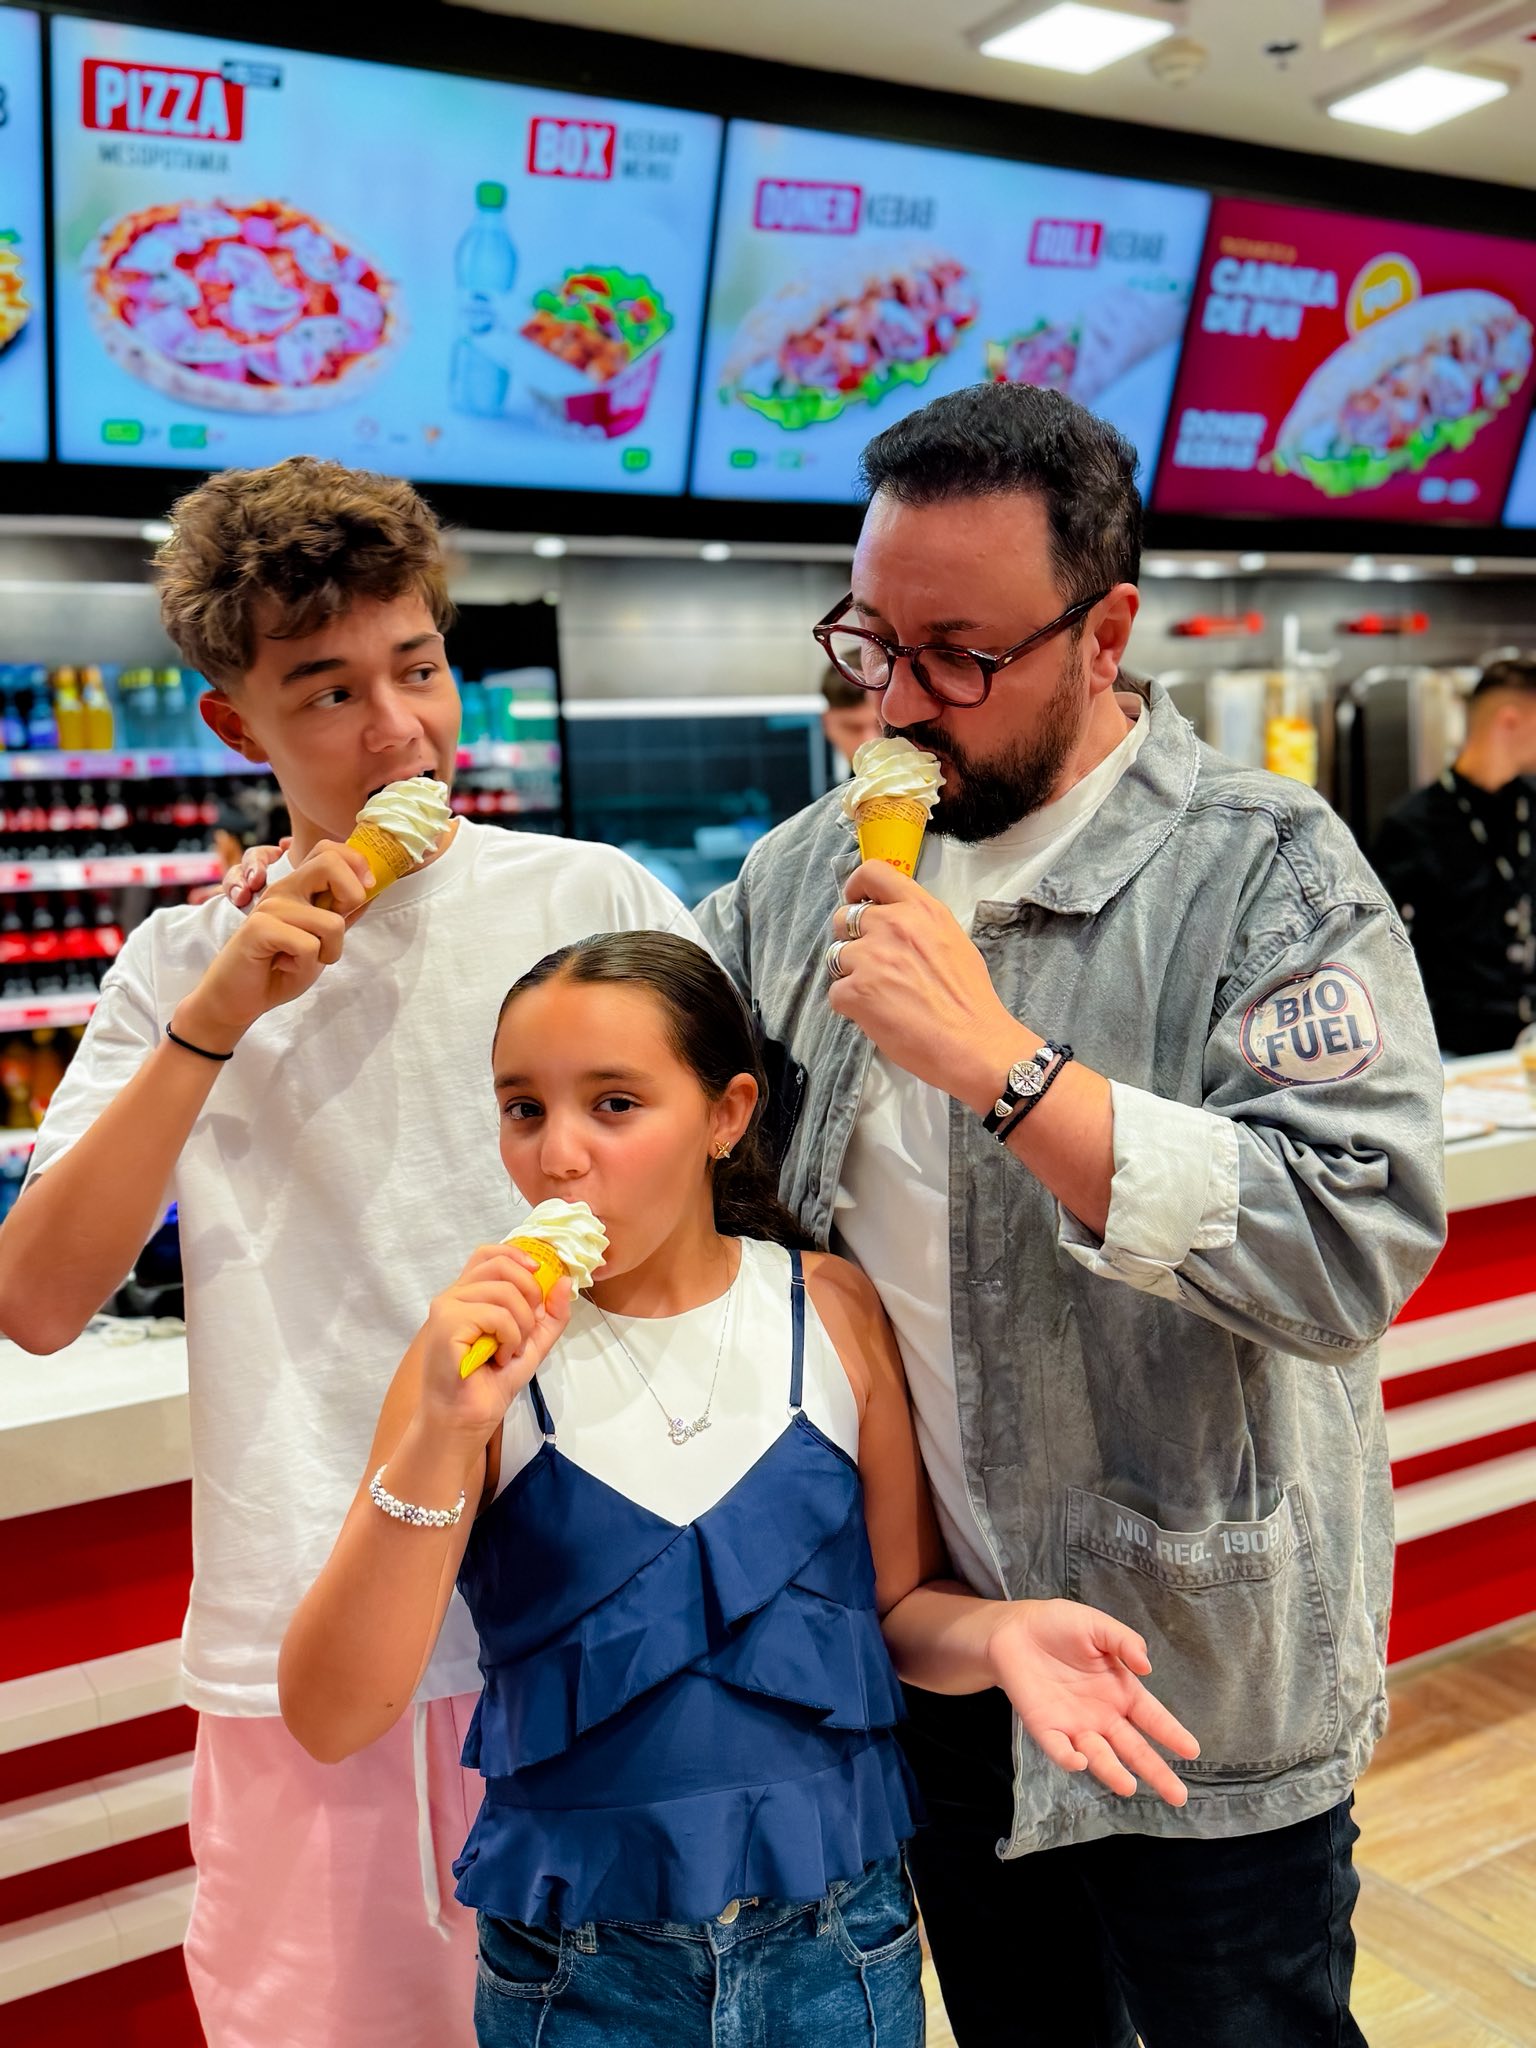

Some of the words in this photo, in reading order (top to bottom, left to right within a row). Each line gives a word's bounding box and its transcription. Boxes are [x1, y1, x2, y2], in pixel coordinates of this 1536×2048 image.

[95, 65, 231, 139] PIZZA
[536, 122, 609, 177] BOX
[1273, 979, 1348, 1030] BIO
[1265, 1014, 1373, 1068] FUEL
[1115, 1514, 1152, 1551] NO.
[1155, 1538, 1213, 1566] REG.
[1219, 1521, 1281, 1555] 1909
